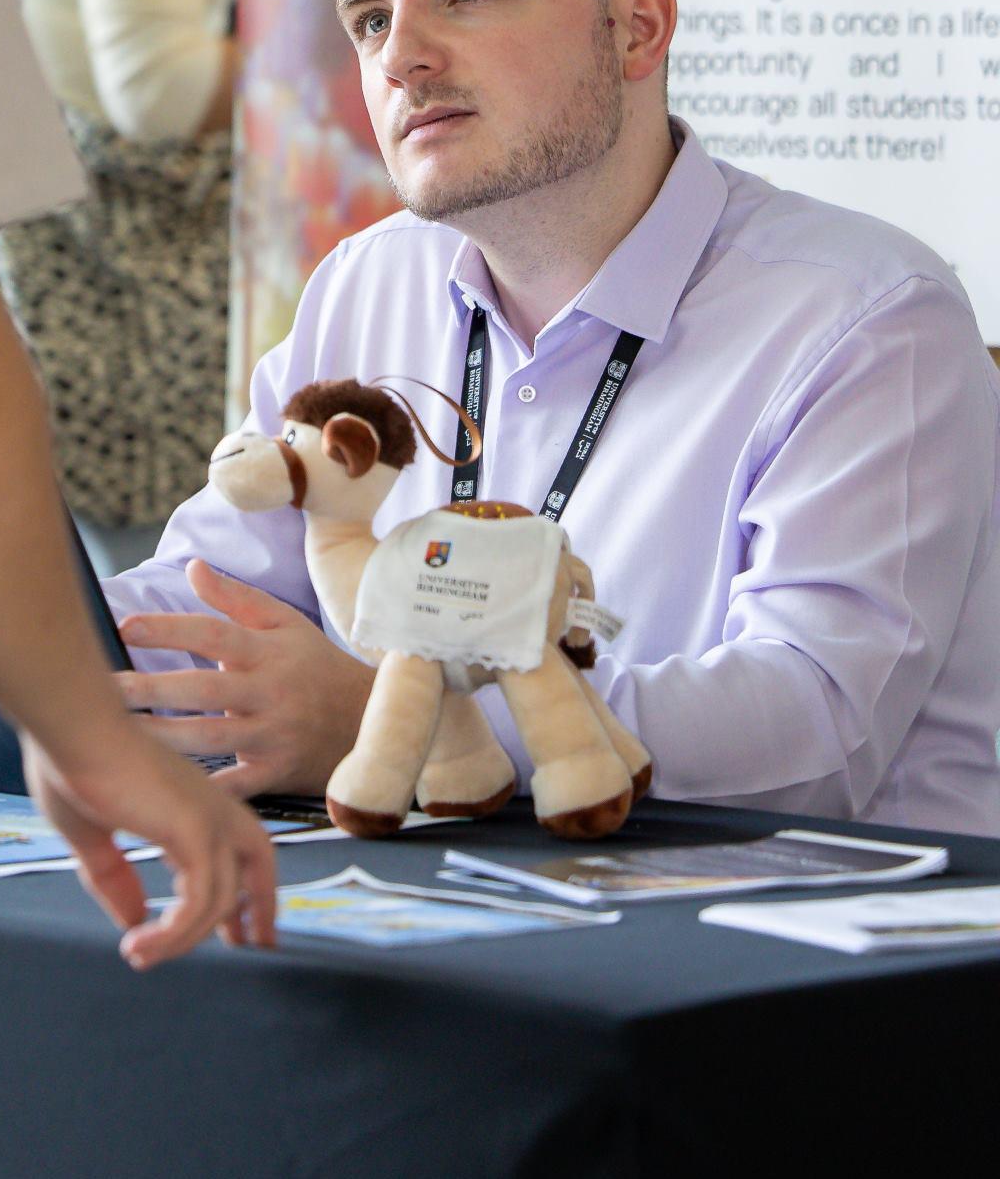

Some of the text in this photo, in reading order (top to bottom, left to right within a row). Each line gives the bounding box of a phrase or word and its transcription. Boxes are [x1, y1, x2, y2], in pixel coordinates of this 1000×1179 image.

[678, 9, 745, 41] ings.
[757, 8, 775, 33] It
[782, 8, 801, 35] is
[810, 12, 825, 36] a
[832, 12, 899, 36] once
[908, 8, 930, 35] in
[939, 13, 954, 37] a
[849, 51, 899, 77] and
[936, 51, 944, 77] I
[808, 91, 837, 117] all
[846, 93, 966, 120] students
[977, 95, 1000, 121] to
[699, 131, 944, 161] mselves out there!
[585, 379, 613, 433] BIRMINGHAM
[579, 442, 592, 460] DUBAI
